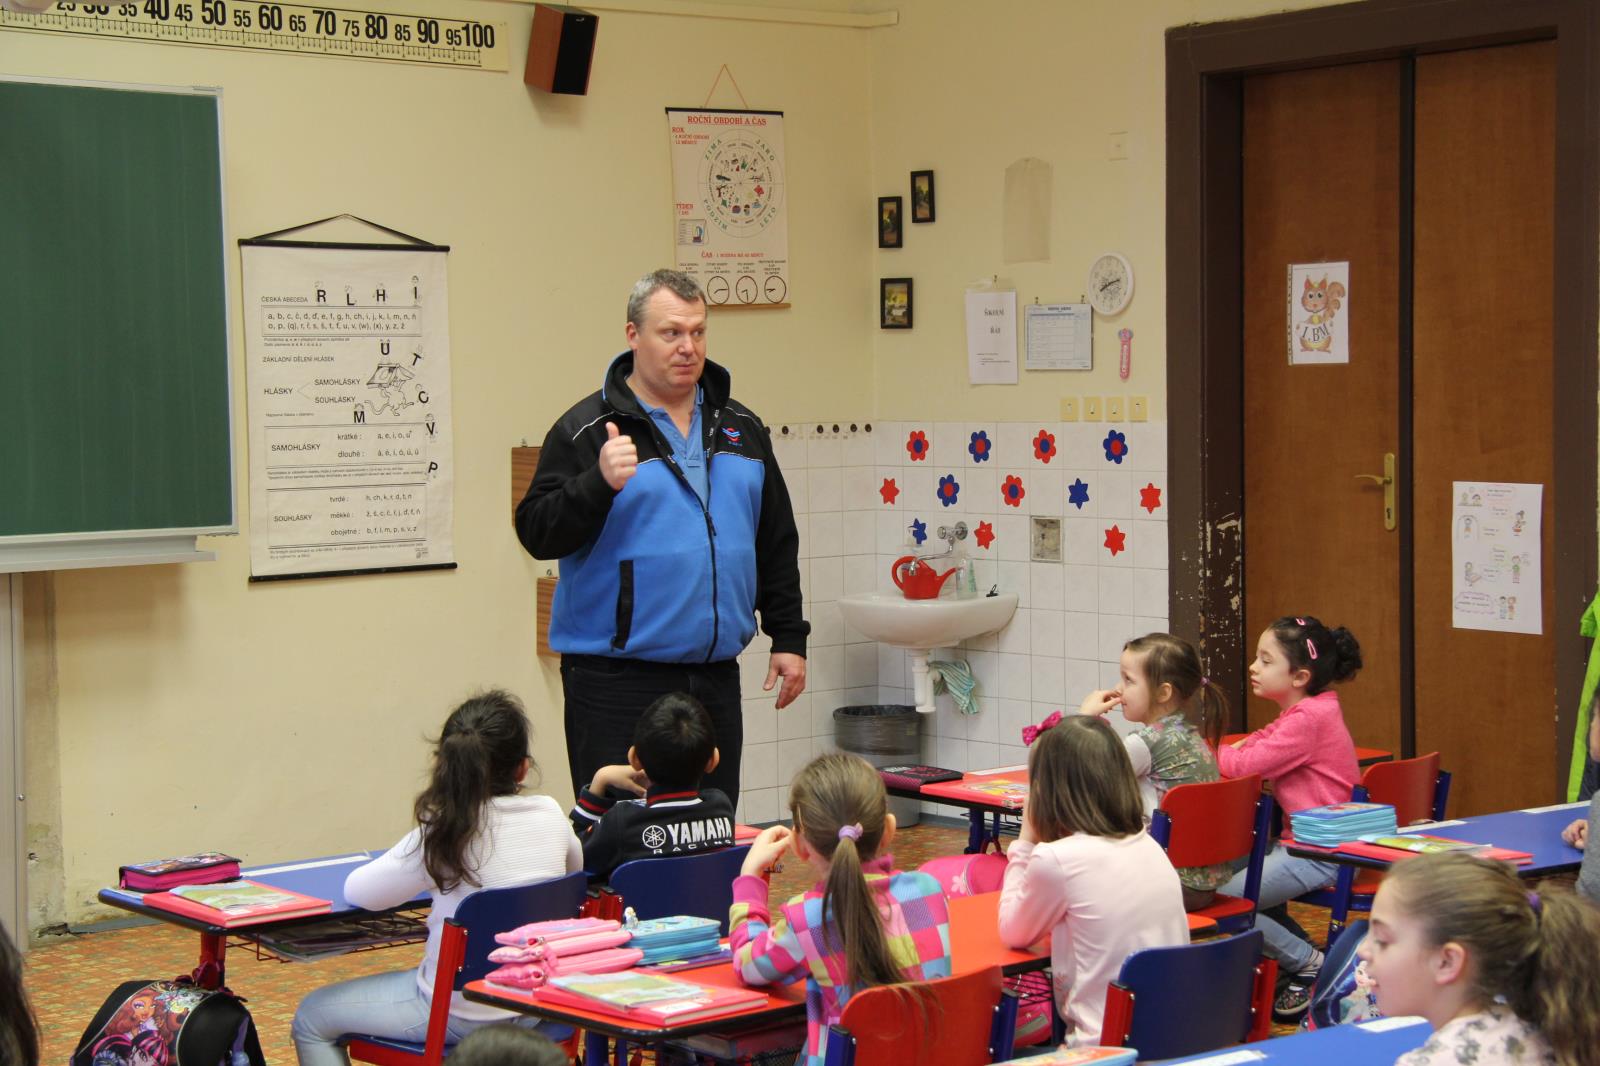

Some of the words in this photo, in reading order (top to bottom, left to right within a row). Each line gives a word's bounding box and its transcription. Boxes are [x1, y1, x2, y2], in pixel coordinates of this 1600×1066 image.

[144, 0, 170, 21] 40
[175, 4, 193, 22] 45
[201, 0, 226, 26] 50
[233, 9, 251, 28] 55
[258, 5, 283, 31] 60
[289, 14, 306, 32] 65
[313, 10, 337, 36] 70
[343, 19, 360, 37] 75
[365, 14, 388, 40] 80
[395, 23, 411, 42] 85
[417, 19, 440, 44] 90
[446, 28, 462, 46] 95
[461, 23, 495, 49] 100
[688, 115, 712, 124] ROČNÍ
[745, 117, 751, 125] A
[752, 116, 767, 126] ČAS
[316, 289, 327, 303] R
[346, 293, 356, 306] L
[376, 289, 386, 302] H
[412, 353, 422, 366] T
[418, 391, 429, 404] C
[353, 411, 365, 424] M
[426, 422, 435, 436] V
[428, 461, 439, 474] P
[667, 817, 732, 846] YAMAHA
[653, 839, 732, 855] RACING
